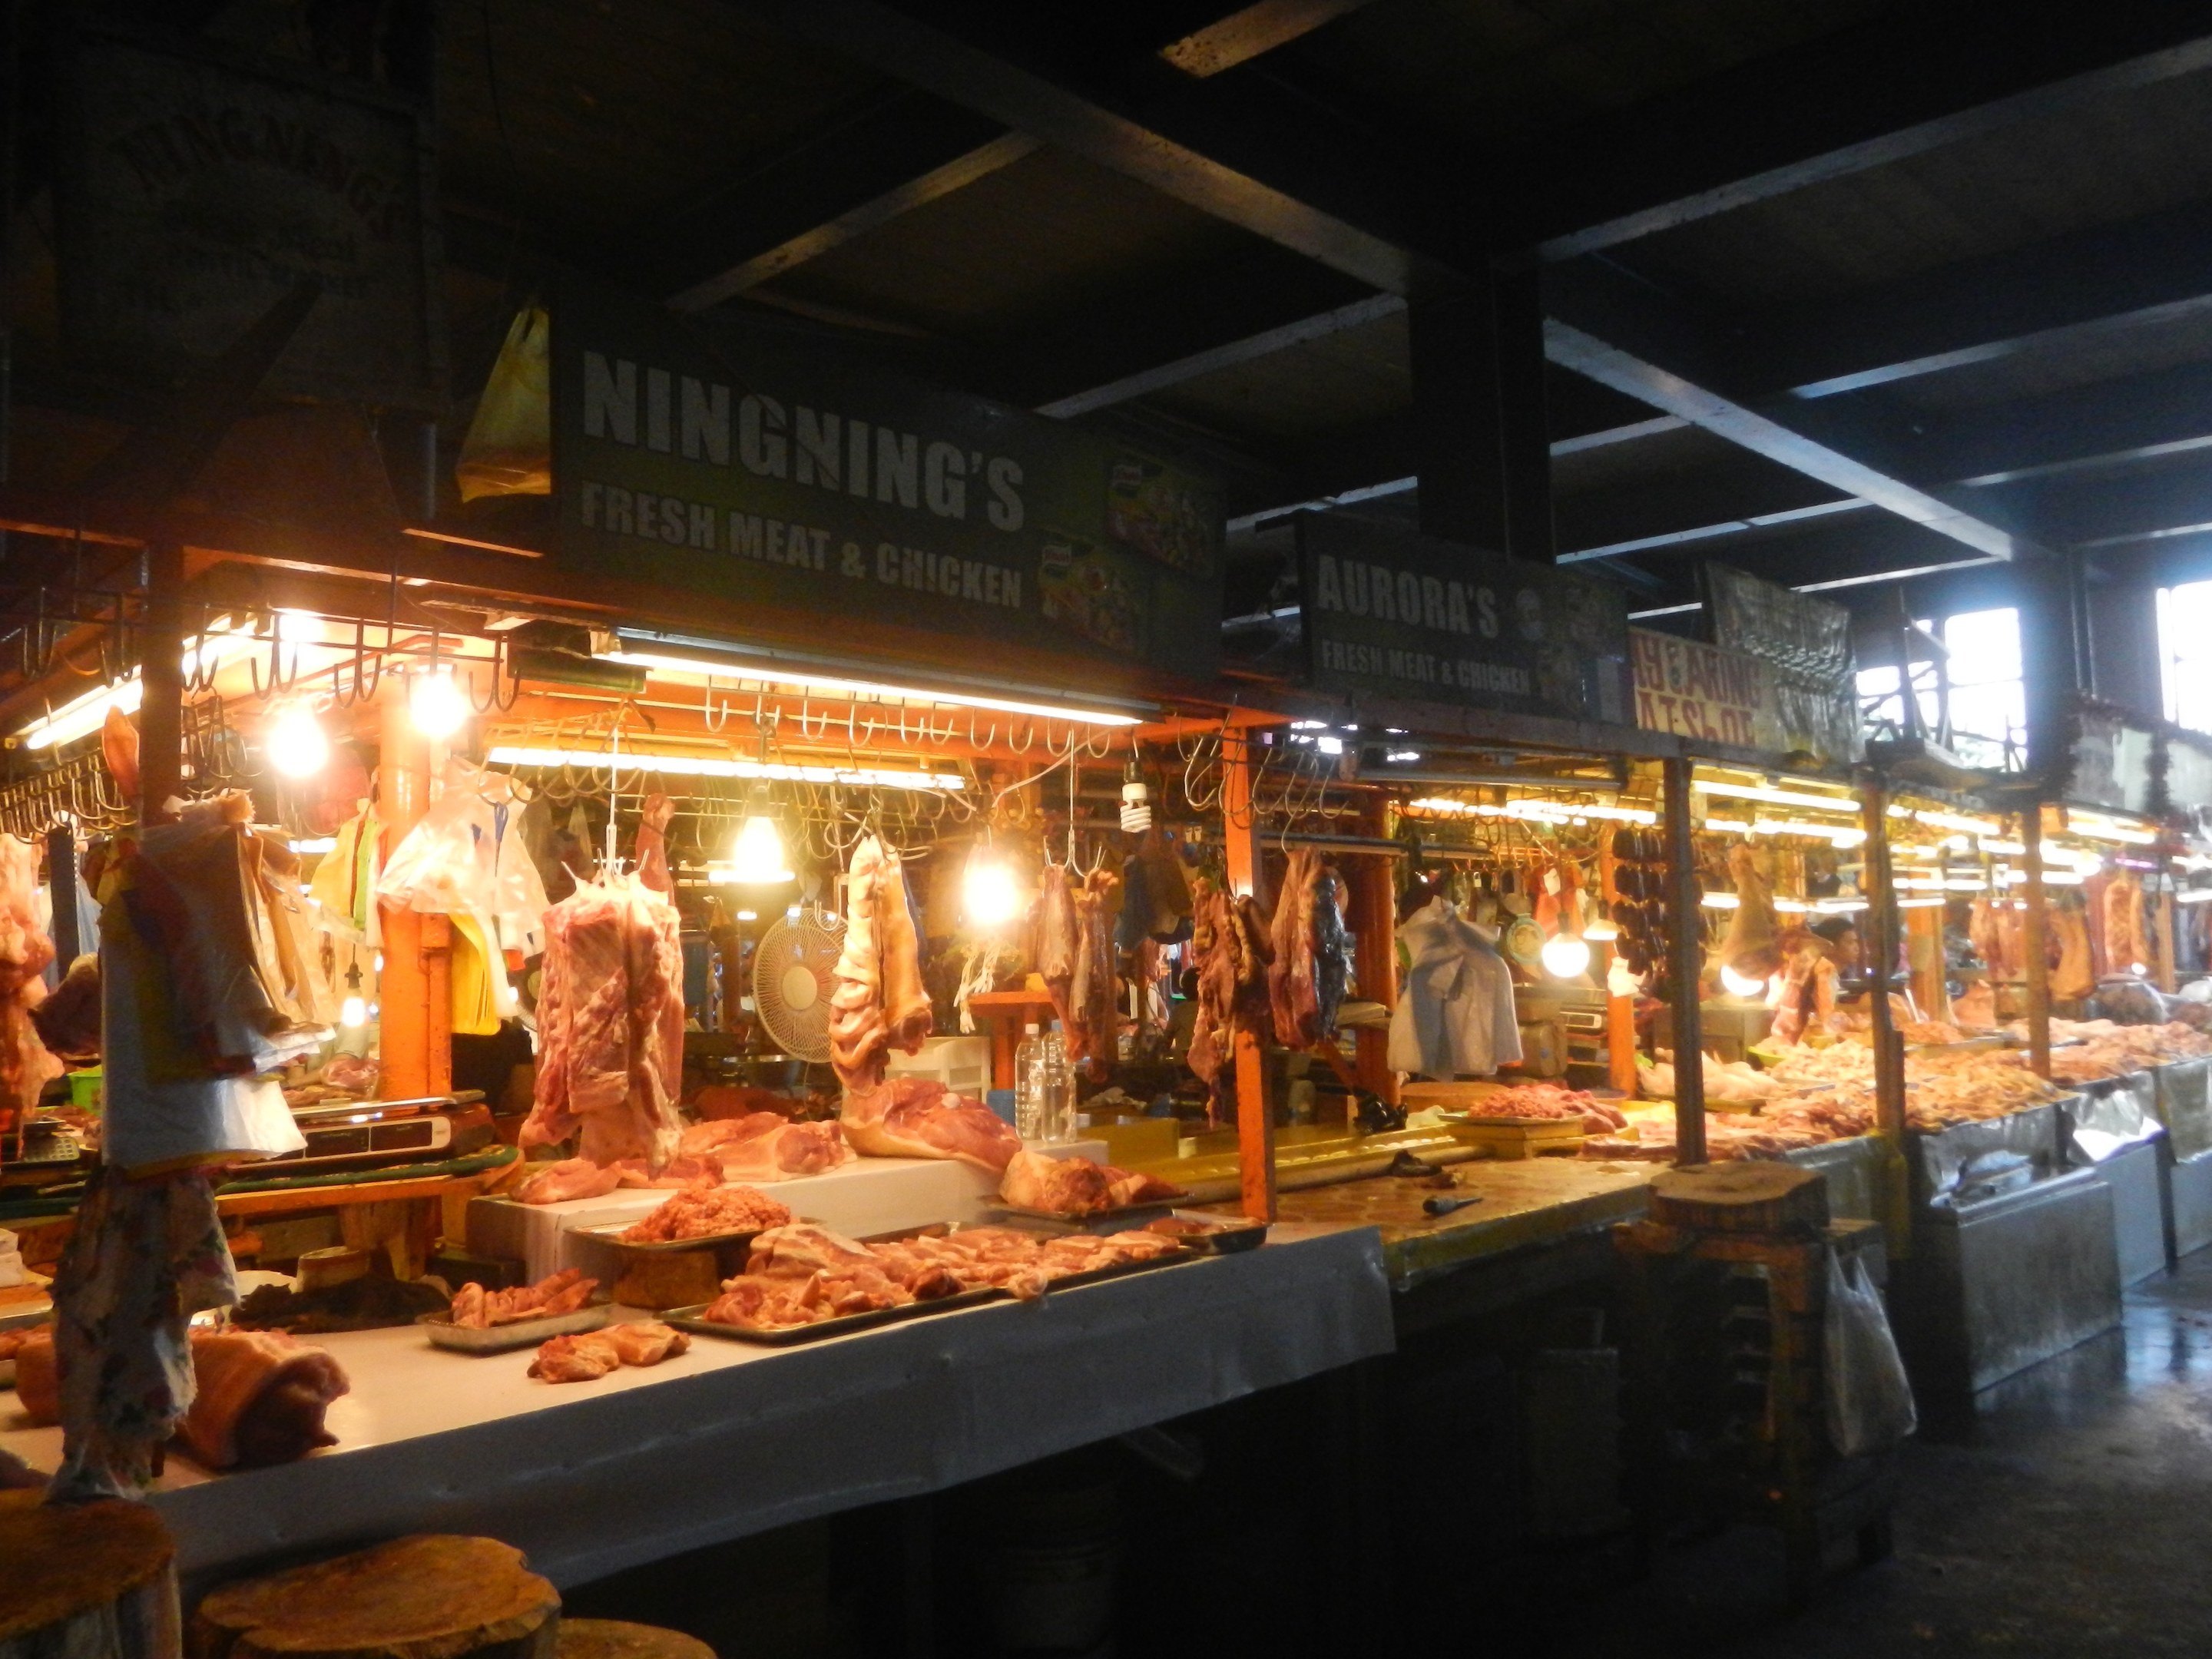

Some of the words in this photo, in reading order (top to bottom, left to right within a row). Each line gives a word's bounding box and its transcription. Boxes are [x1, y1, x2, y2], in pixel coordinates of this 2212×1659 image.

[584, 349, 1024, 531] NINGNING'S
[581, 480, 715, 550] FRESH
[730, 512, 830, 571] MEAT
[841, 542, 866, 578] &
[877, 542, 1022, 608] CHICKEN
[1317, 555, 1498, 638] AURORA'S
[1322, 639, 1382, 675] FRESH
[1389, 649, 1435, 682] MEAT
[1442, 662, 1453, 684] &
[1458, 660, 1530, 695] CHICKEN
